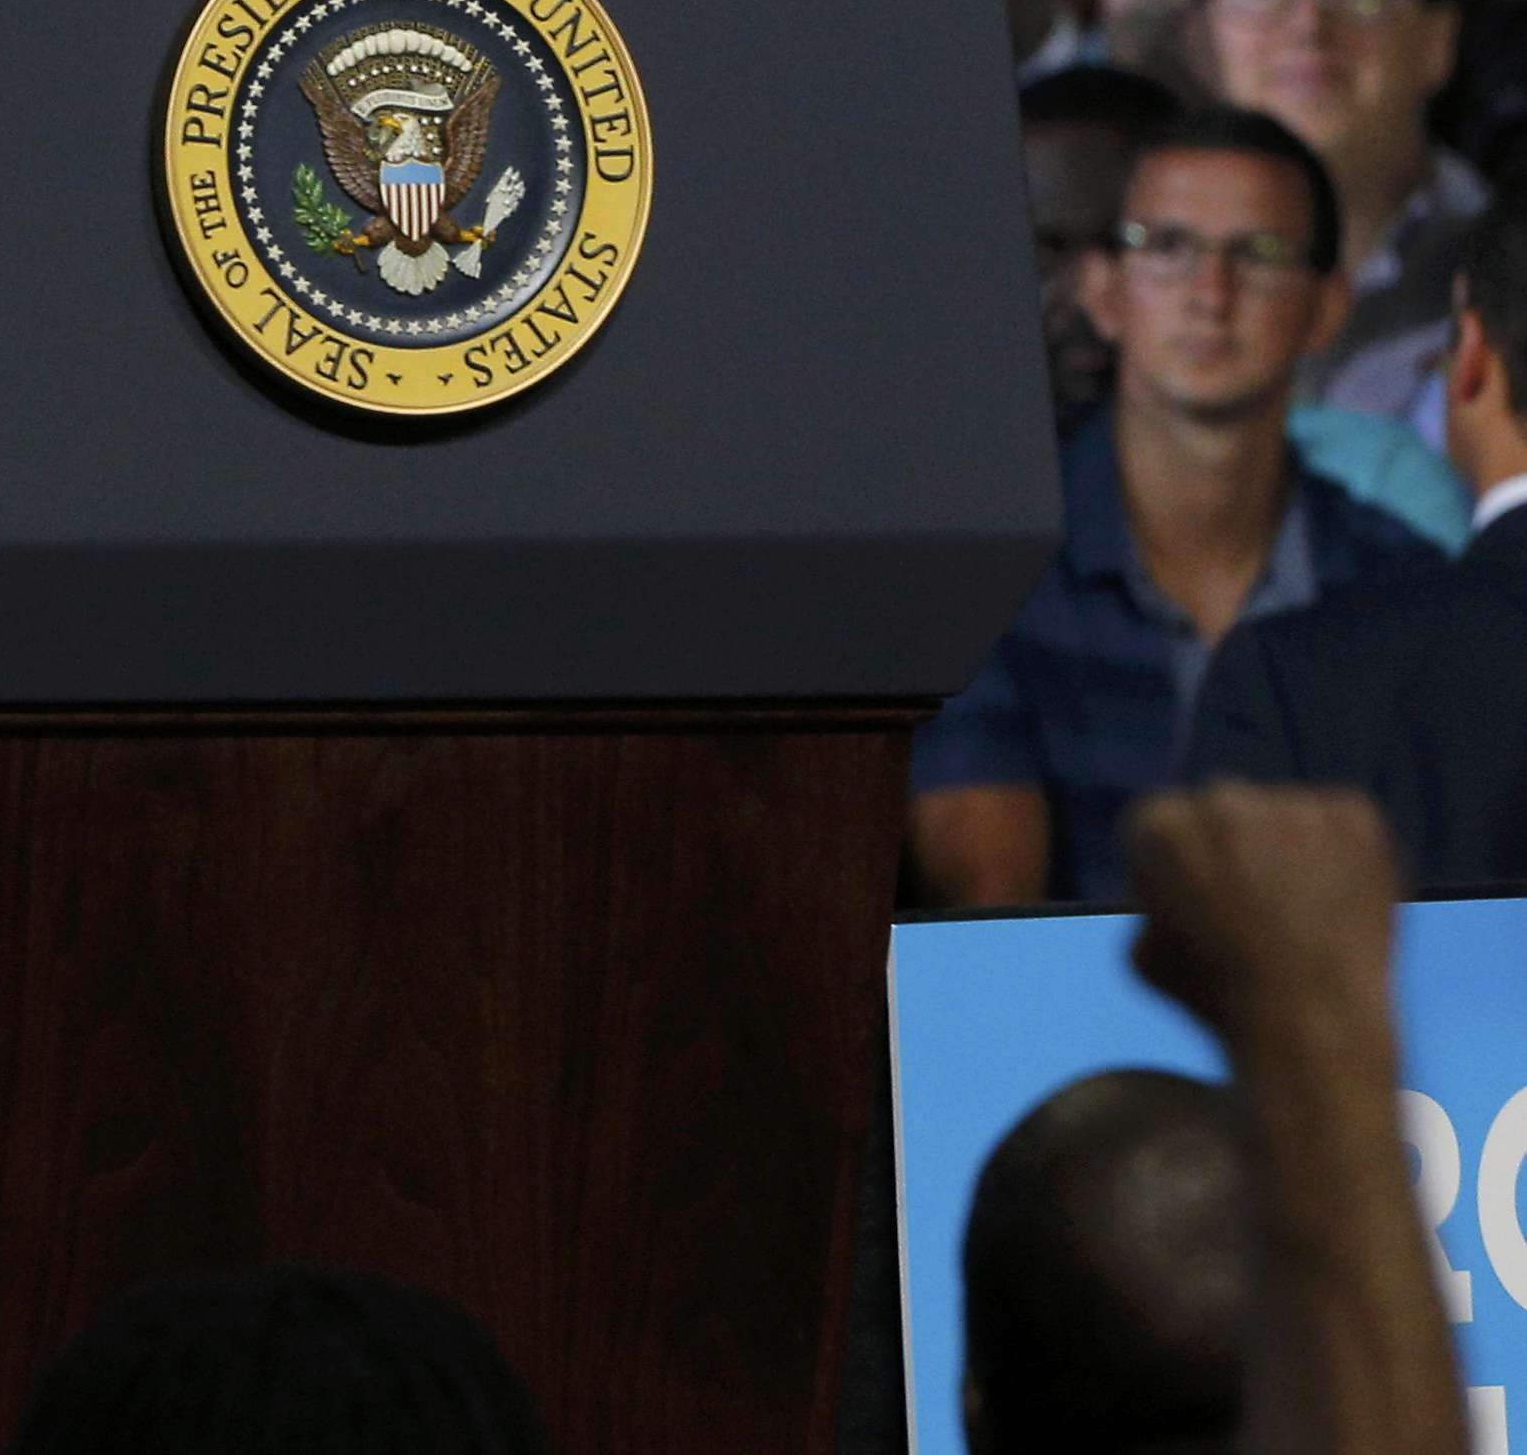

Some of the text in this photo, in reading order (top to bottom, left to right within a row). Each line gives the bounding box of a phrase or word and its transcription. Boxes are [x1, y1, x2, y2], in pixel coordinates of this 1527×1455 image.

[188, 168, 227, 241] THE
[210, 247, 250, 291] OF
[463, 230, 620, 389] STATES
[253, 285, 377, 392] SEAL
